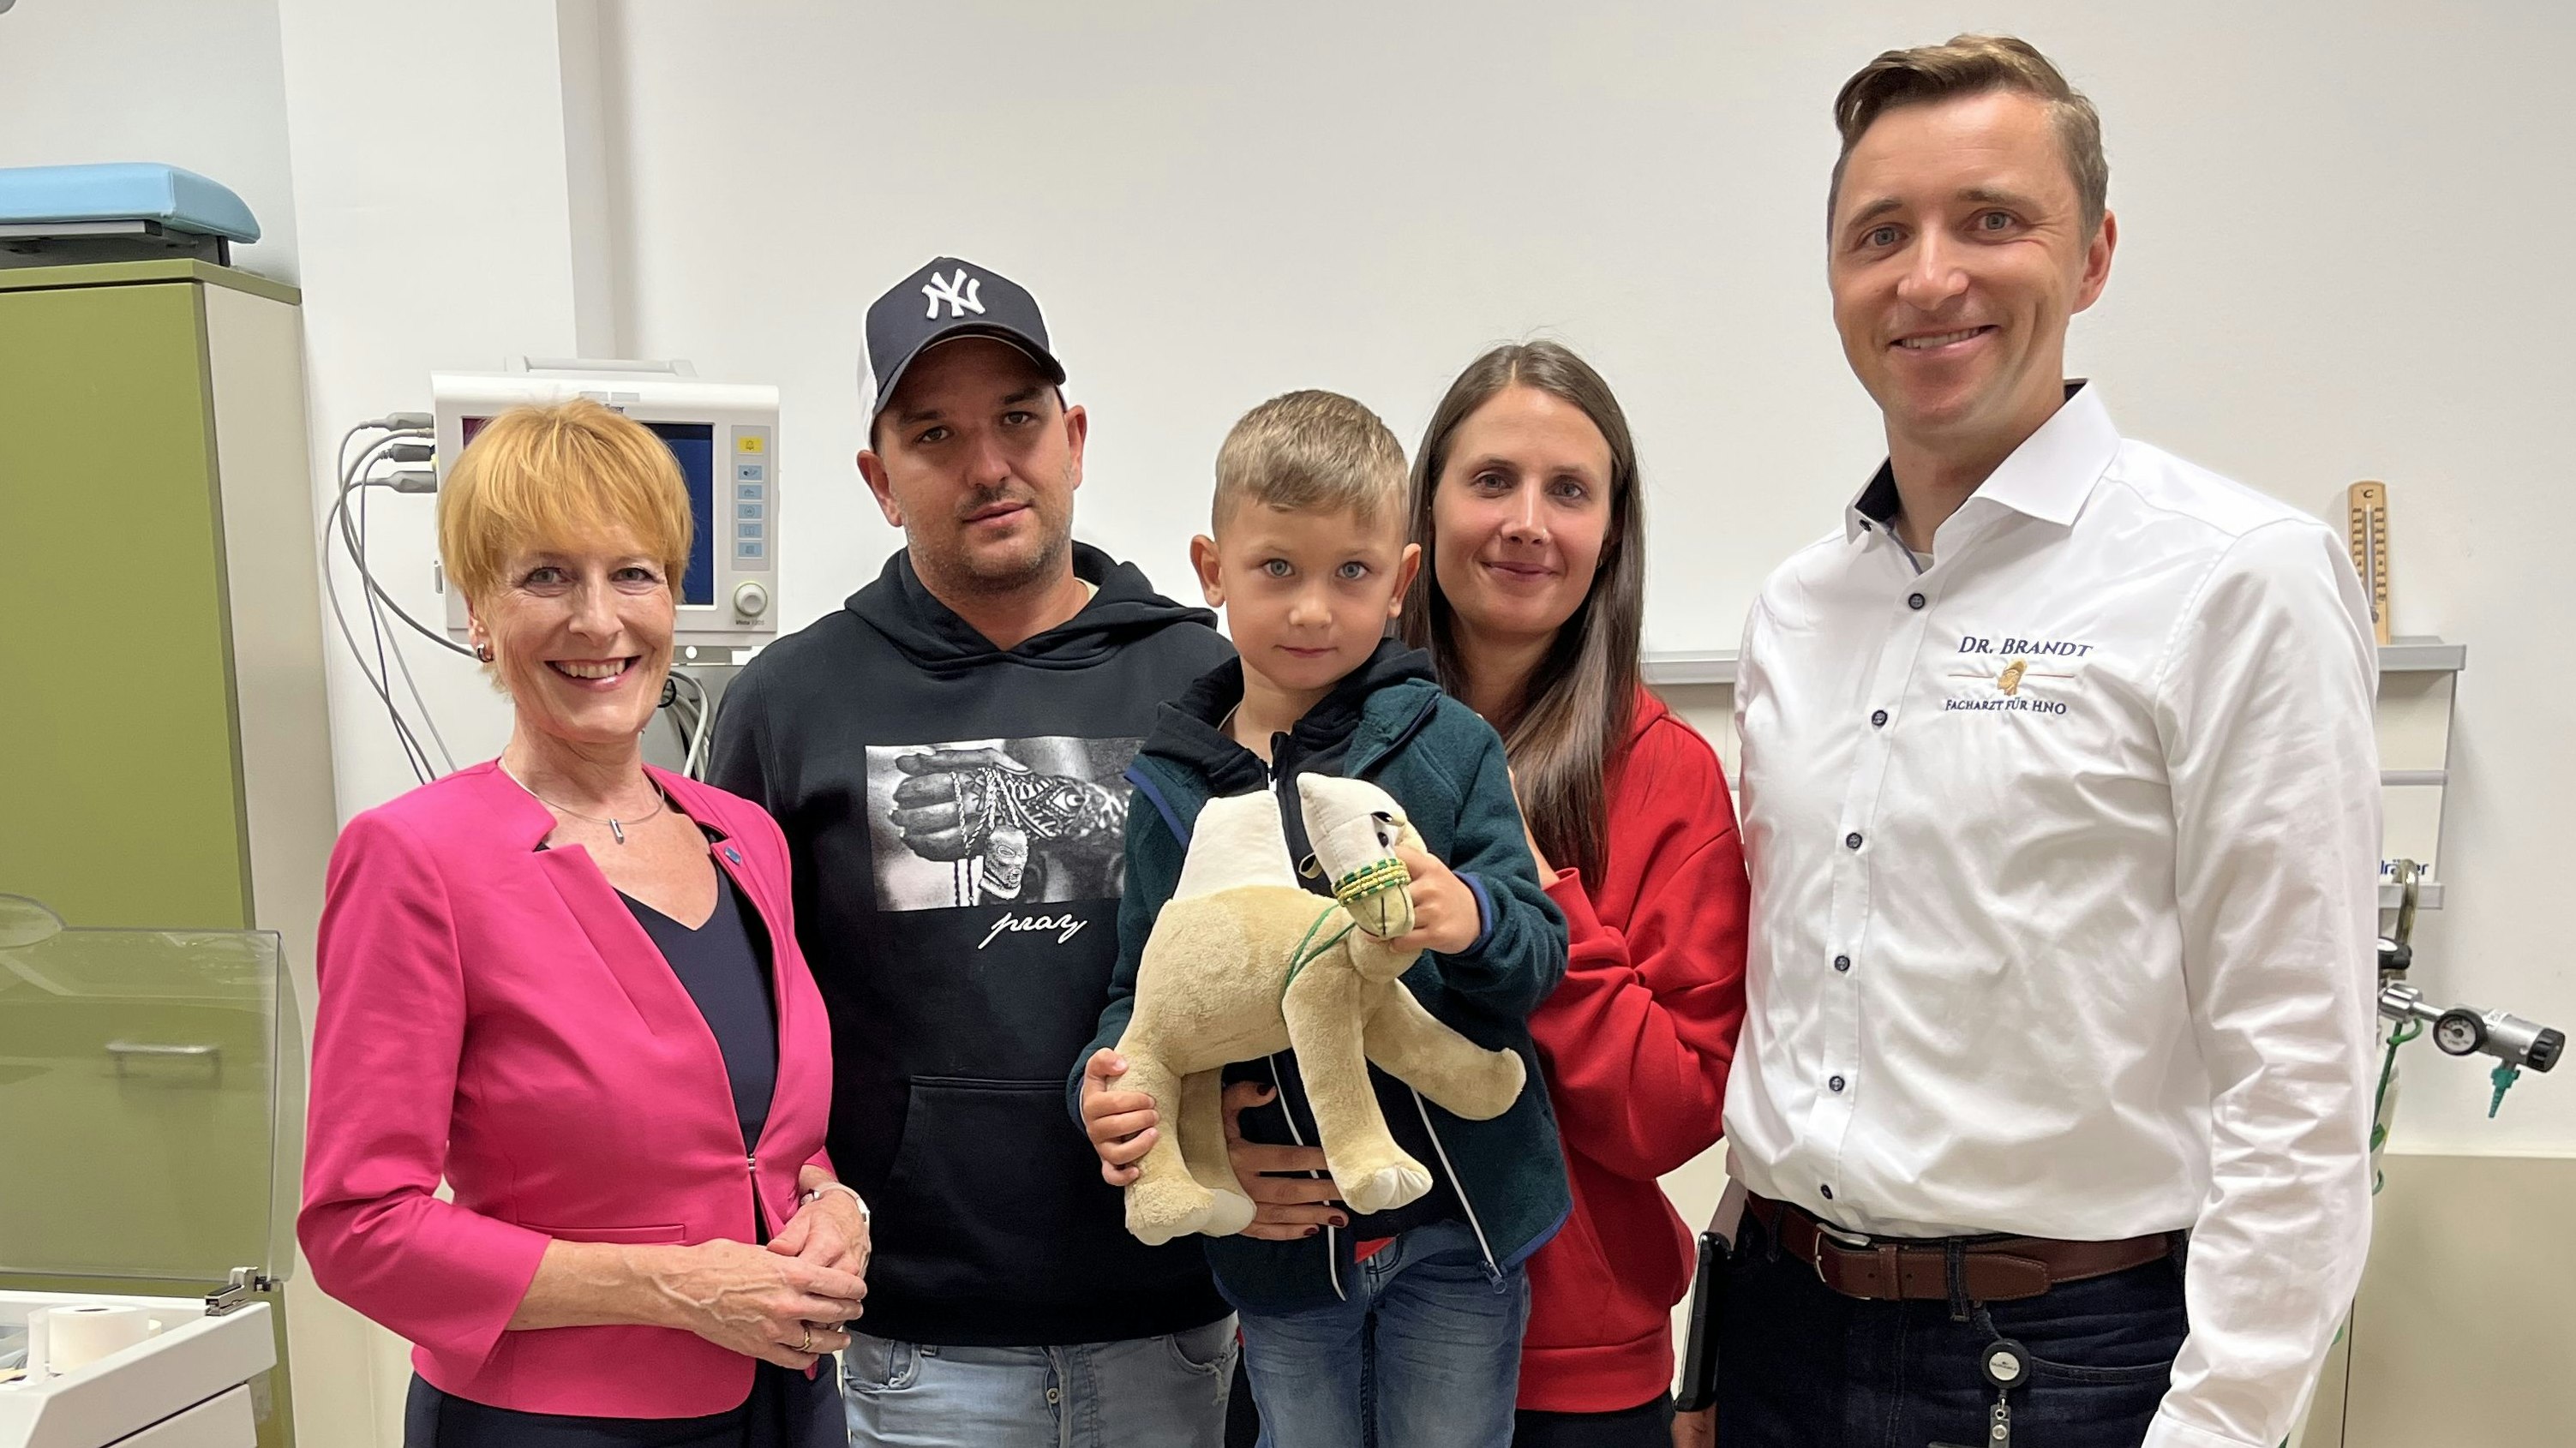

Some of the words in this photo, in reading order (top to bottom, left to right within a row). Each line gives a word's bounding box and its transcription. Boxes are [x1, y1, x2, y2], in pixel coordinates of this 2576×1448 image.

[921, 268, 986, 320] NY
[2032, 700, 2067, 715] HNO
[978, 912, 1087, 949] pray
